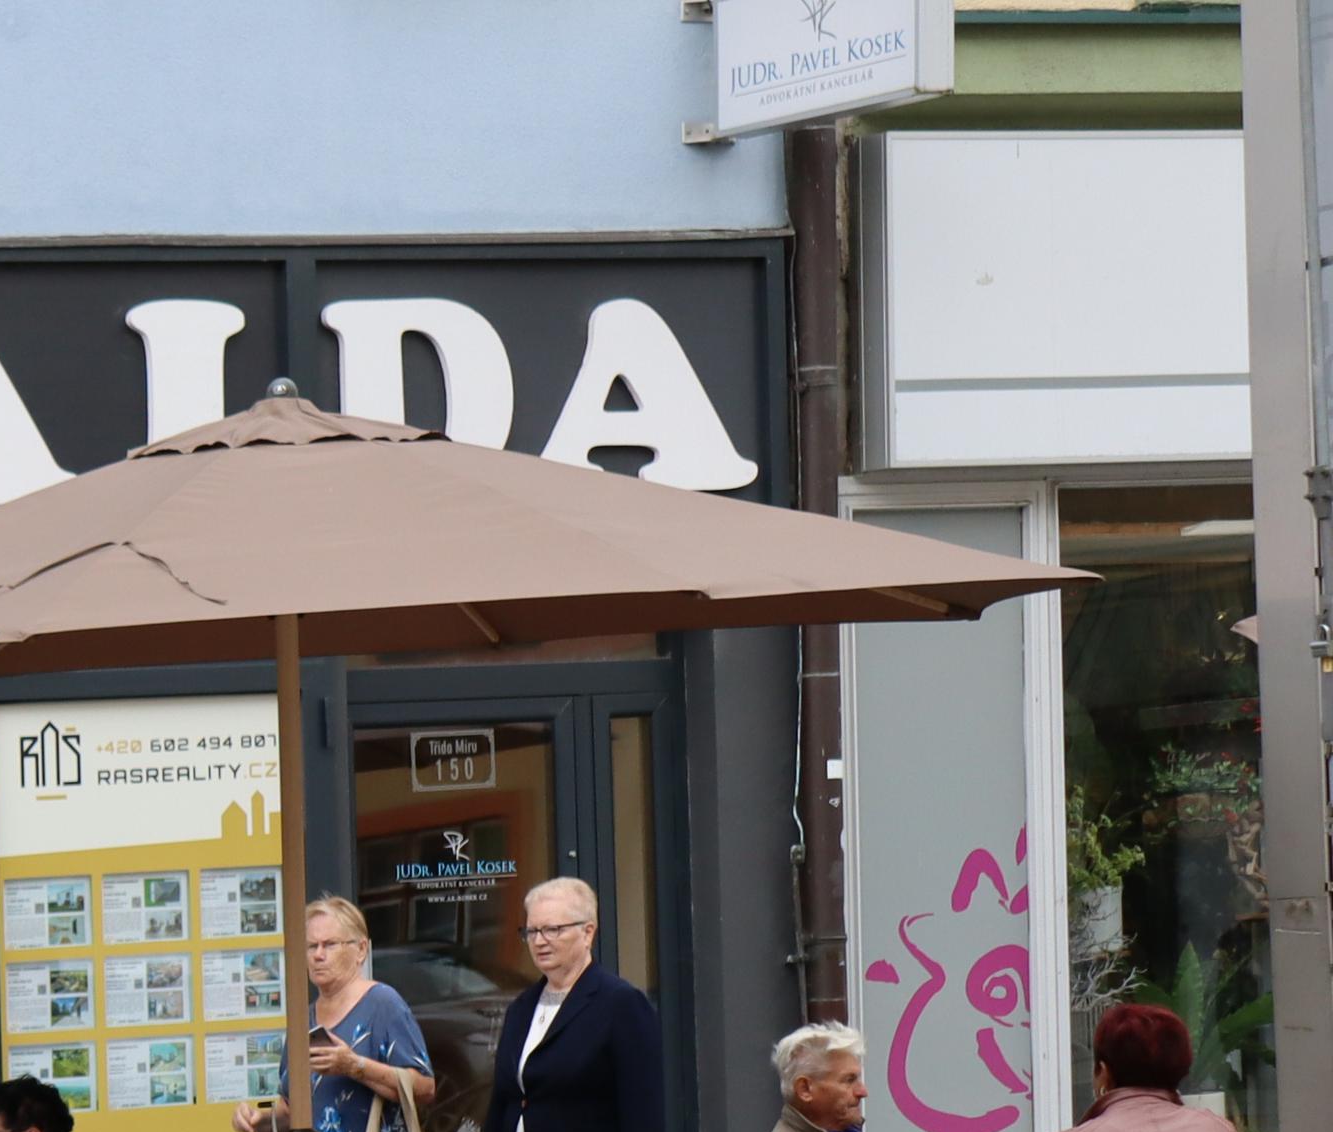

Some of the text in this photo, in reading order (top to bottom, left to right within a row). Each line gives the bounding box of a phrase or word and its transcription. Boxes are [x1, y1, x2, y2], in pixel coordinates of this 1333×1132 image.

[789, 46, 841, 78] PAVEL
[846, 29, 906, 63] KOSEK
[96, 733, 277, 755] +420 602 494 807
[97, 761, 278, 786] RASREALITY.CZ
[437, 861, 471, 876] PAVEL
[476, 859, 517, 874] KOSEK
